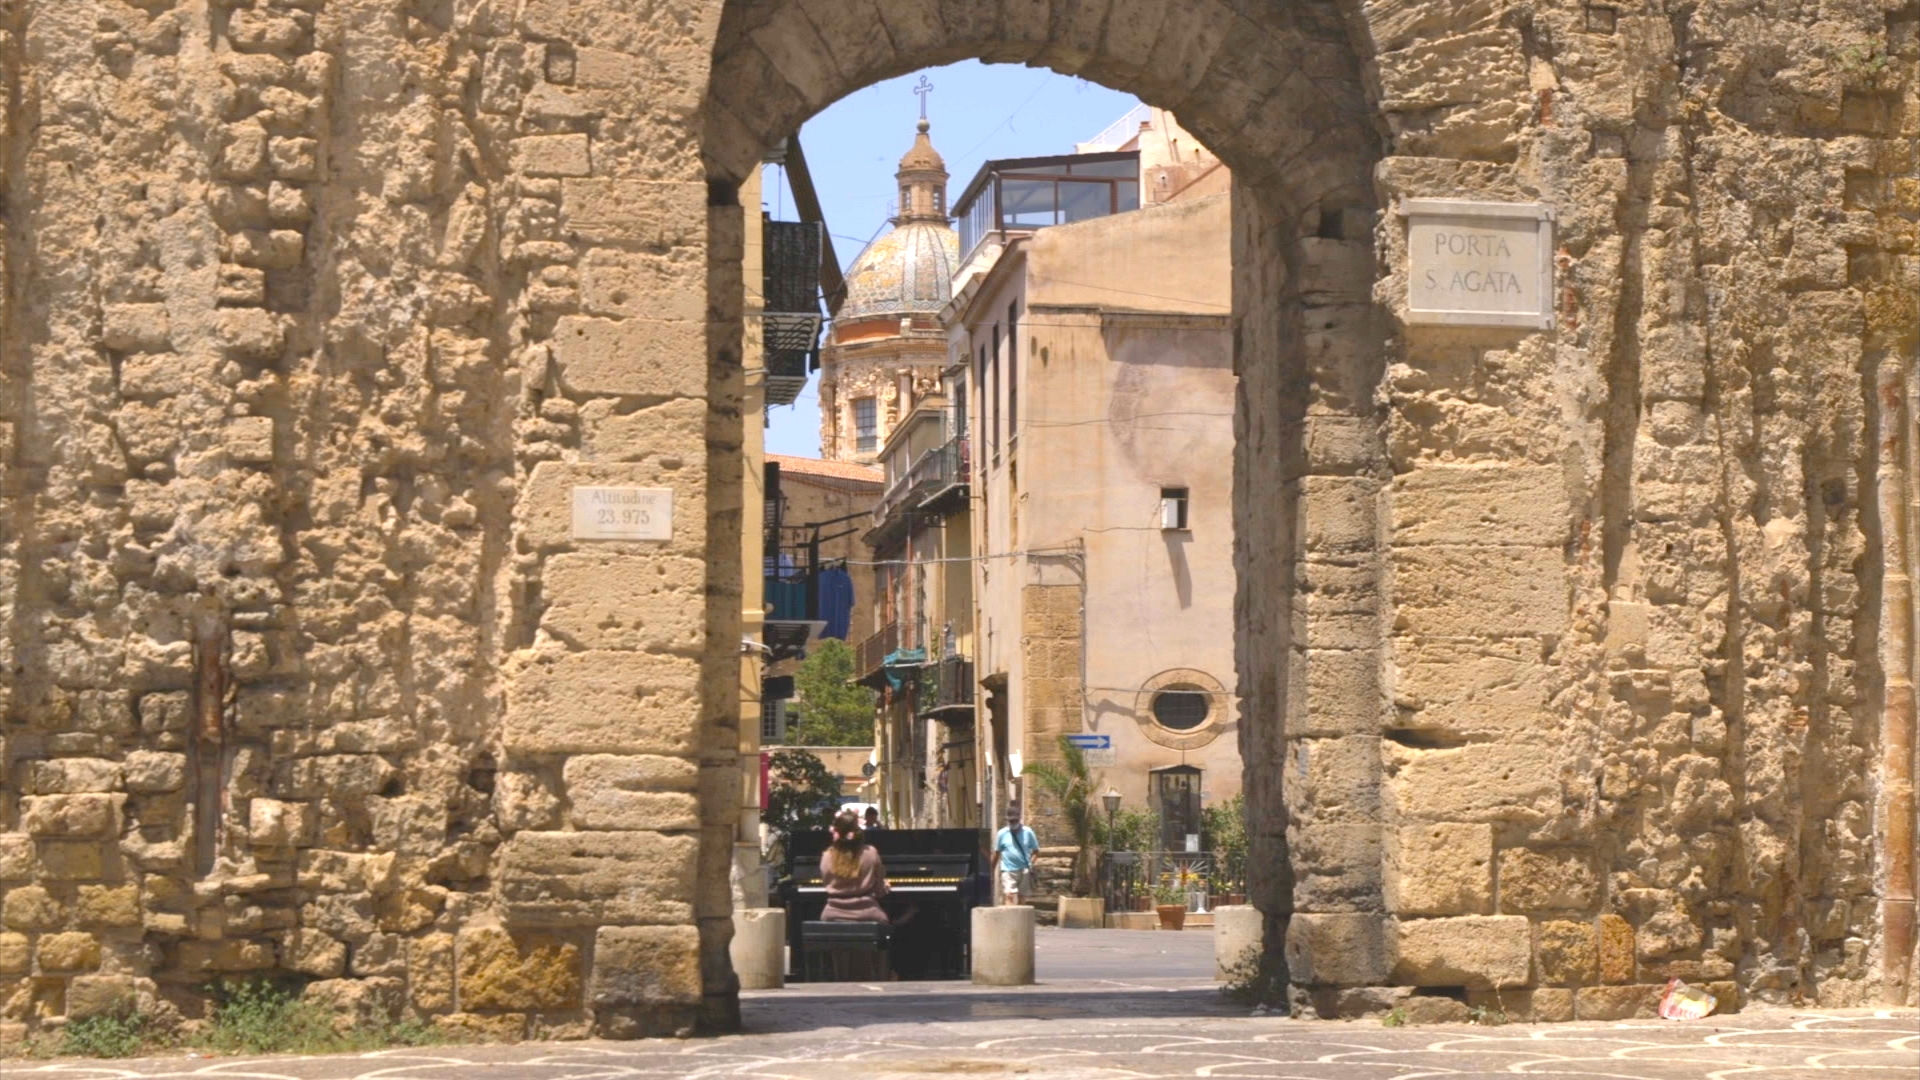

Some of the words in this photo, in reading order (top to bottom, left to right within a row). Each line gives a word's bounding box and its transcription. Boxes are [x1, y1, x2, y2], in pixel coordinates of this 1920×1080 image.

[1435, 233, 1511, 257] PORTA
[1450, 271, 1522, 293] AGATA
[590, 490, 657, 505] Altitudine
[597, 508, 651, 525] 23.975
